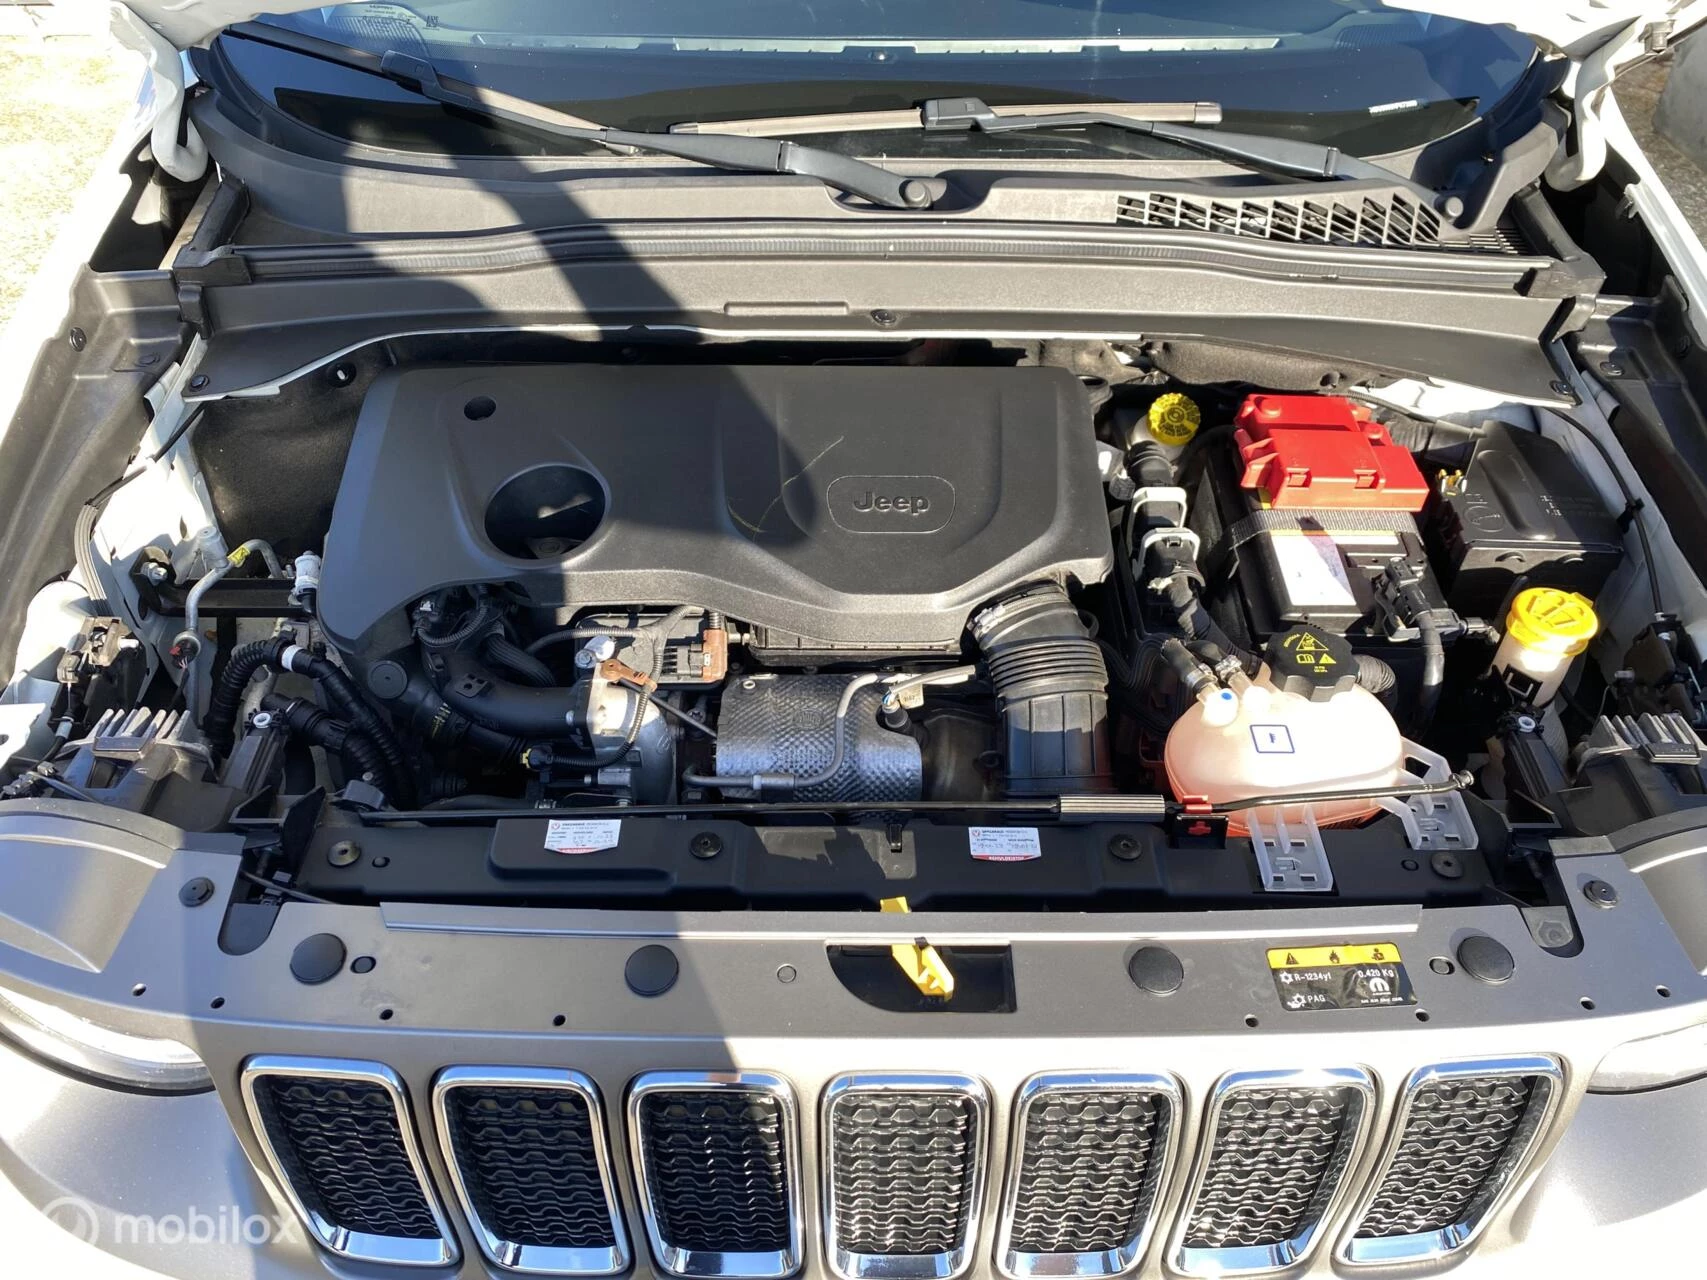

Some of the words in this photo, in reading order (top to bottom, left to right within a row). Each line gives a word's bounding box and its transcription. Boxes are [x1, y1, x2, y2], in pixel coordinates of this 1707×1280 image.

[853, 491, 931, 515] Jeep
[1382, 968, 1395, 978] Kg
[1308, 994, 1326, 1003] PAG
